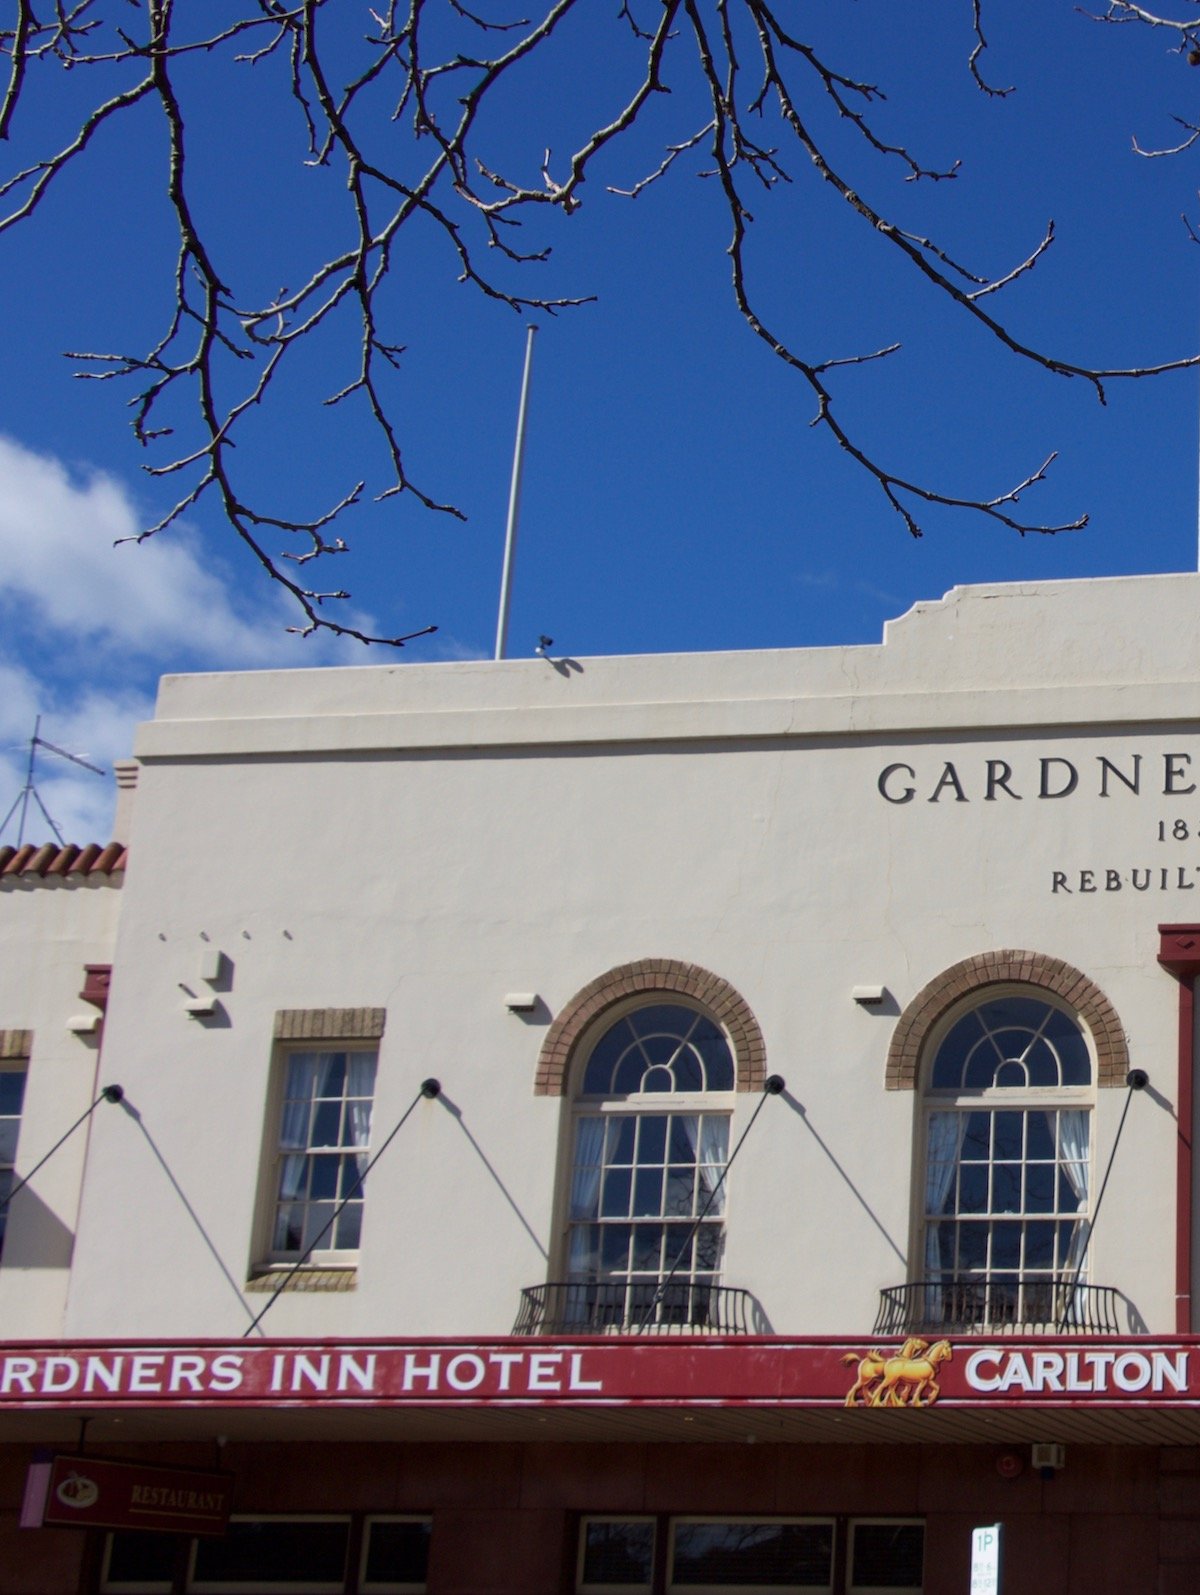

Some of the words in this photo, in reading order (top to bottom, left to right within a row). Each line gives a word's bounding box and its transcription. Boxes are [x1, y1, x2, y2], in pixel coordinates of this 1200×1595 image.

[0, 1354, 244, 1393] RDNERS
[271, 1354, 377, 1391] INN
[402, 1353, 603, 1391] HOTEL
[964, 1348, 1189, 1393] CARLTON
[130, 1485, 225, 1511] RESTAURANT
[977, 1534, 993, 1552] 1P
